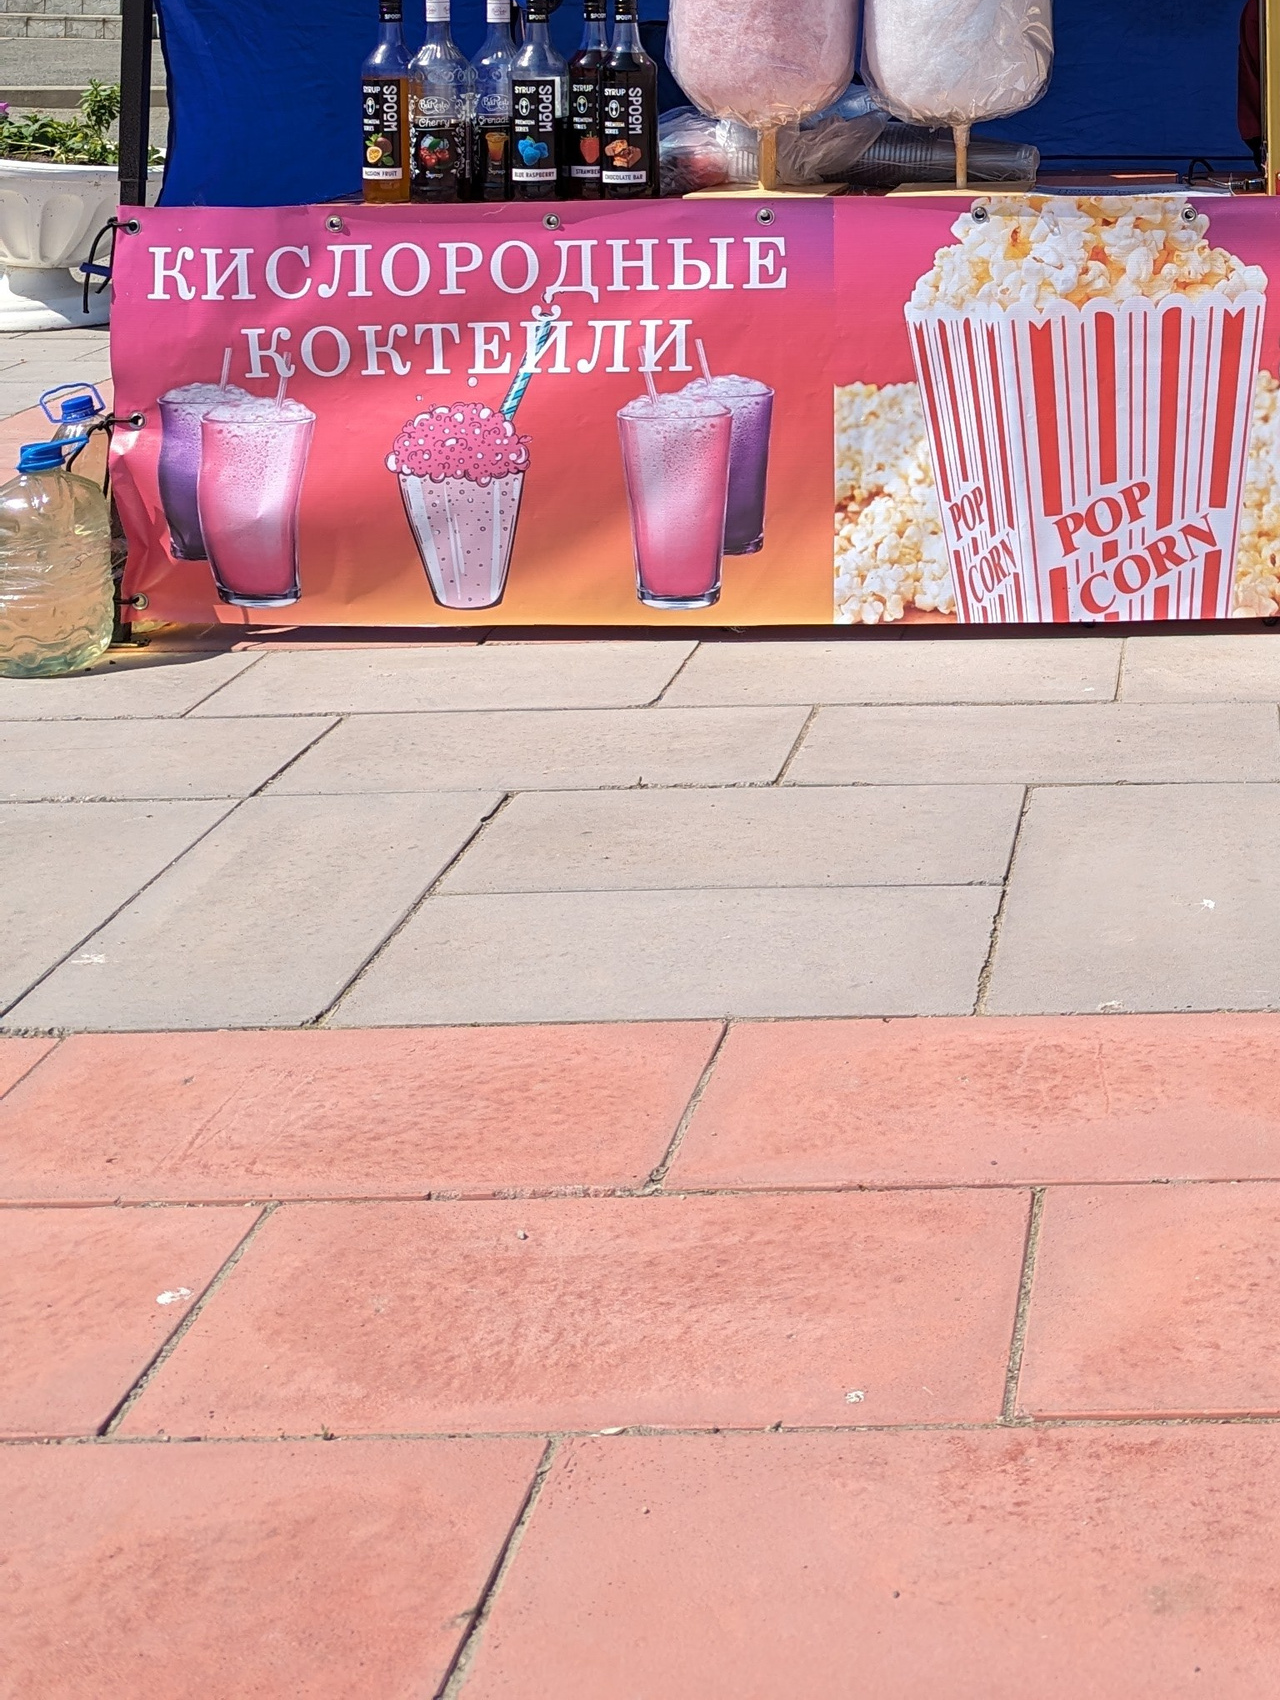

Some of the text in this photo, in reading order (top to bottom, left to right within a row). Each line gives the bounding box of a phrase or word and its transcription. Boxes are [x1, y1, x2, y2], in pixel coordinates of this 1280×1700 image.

[383, 85, 398, 132] SPOOM
[514, 86, 536, 94] SYRUP
[539, 85, 553, 132] SPOOM
[604, 88, 626, 96] SYRUP
[628, 87, 643, 134] SPOOM
[418, 118, 450, 128] Cherry
[146, 236, 788, 303] КИСЛОРОДНЫЕ
[244, 304, 694, 379] КОКТЕЙЛИ
[948, 486, 987, 540] POP
[1053, 481, 1153, 557] POP
[967, 535, 1018, 604] CORN
[1079, 513, 1221, 614] CORN
